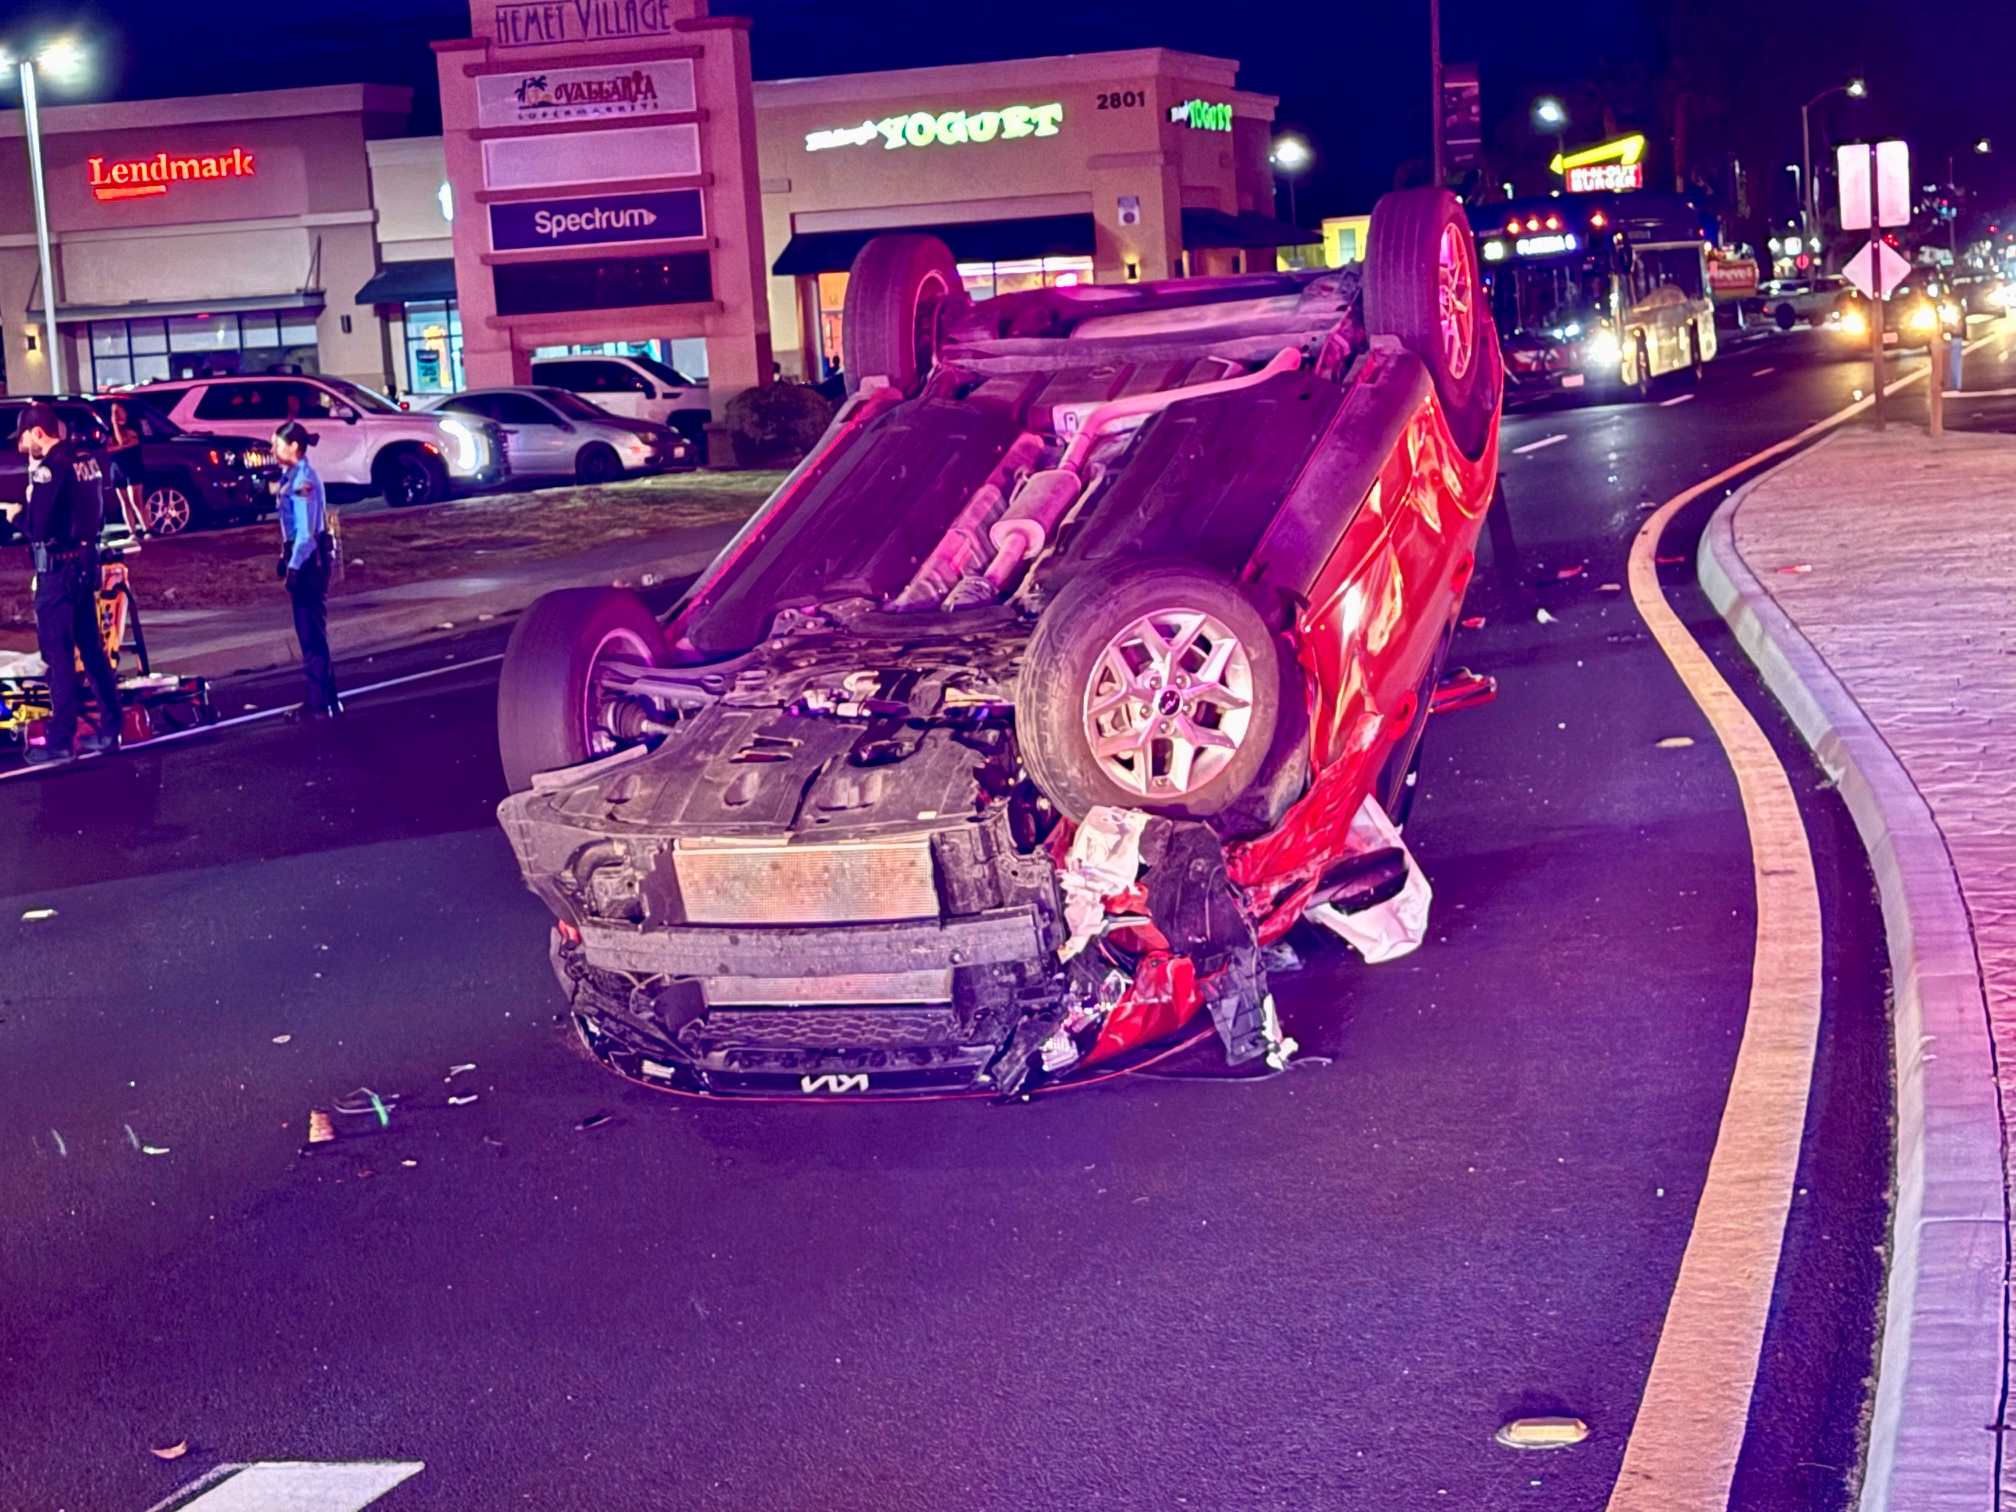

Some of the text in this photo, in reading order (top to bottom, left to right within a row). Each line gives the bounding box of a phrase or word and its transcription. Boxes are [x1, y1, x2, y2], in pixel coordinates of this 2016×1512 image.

[495, 0, 671, 44] HEMET VILLAGE
[1097, 91, 1145, 109] 2801
[1186, 98, 1233, 132] YOGURT
[876, 102, 1063, 149] YOGURT
[88, 147, 255, 185] Lendmark
[534, 207, 652, 239] Spectrum
